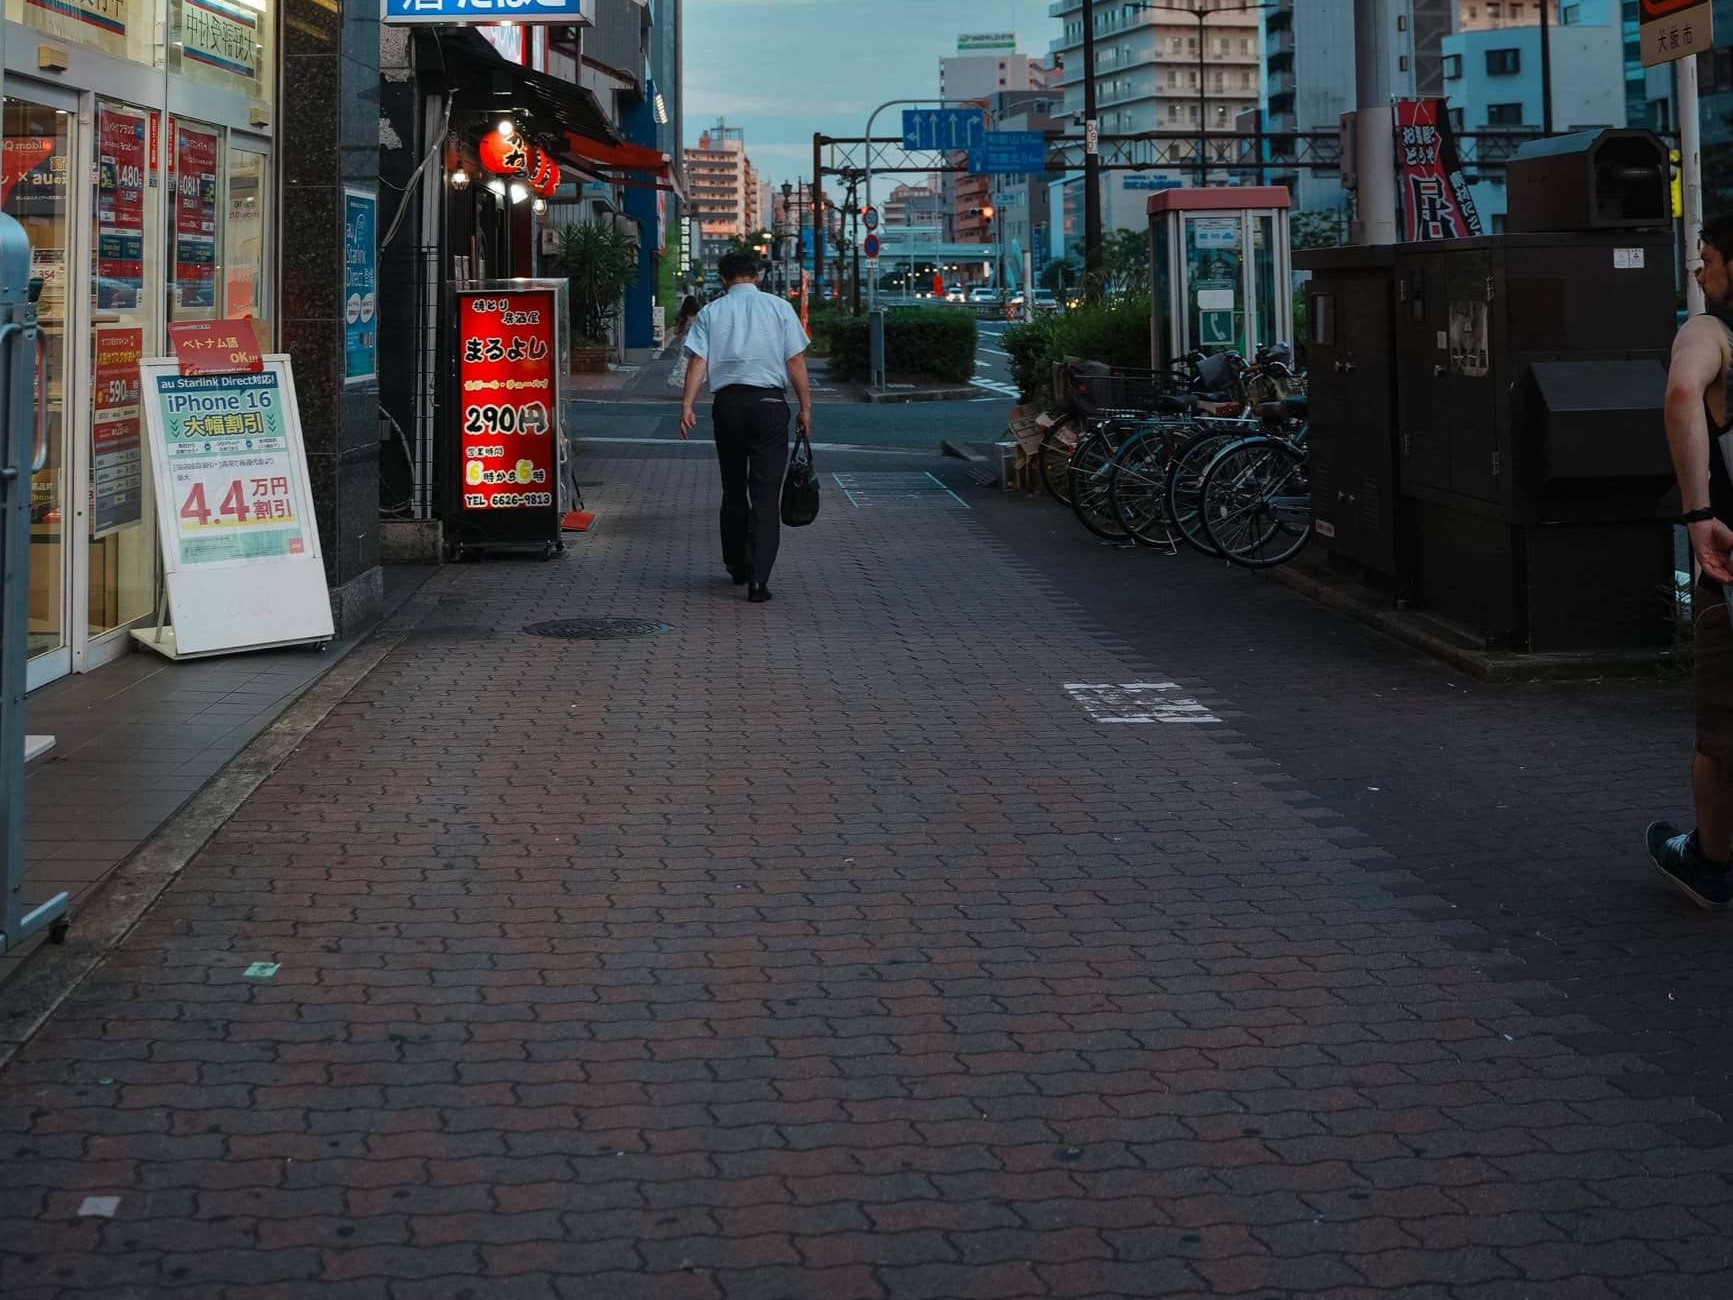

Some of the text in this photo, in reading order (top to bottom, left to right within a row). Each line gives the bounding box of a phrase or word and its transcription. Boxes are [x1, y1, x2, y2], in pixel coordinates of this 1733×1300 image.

[1658, 26, 1693, 53] 大阪市
[501, 310, 540, 325] 居酒屋
[183, 336, 239, 349] ベトナム語
[464, 336, 548, 362] まるよし
[161, 380, 175, 389] au
[178, 378, 219, 390] Starlink
[168, 390, 272, 413] iPhone 16
[183, 411, 265, 438] 大幅割引
[464, 401, 549, 435] 290円
[466, 445, 504, 457] 営業時間
[253, 498, 292, 521] 割引
[464, 492, 552, 508] TEL 6626-9813
